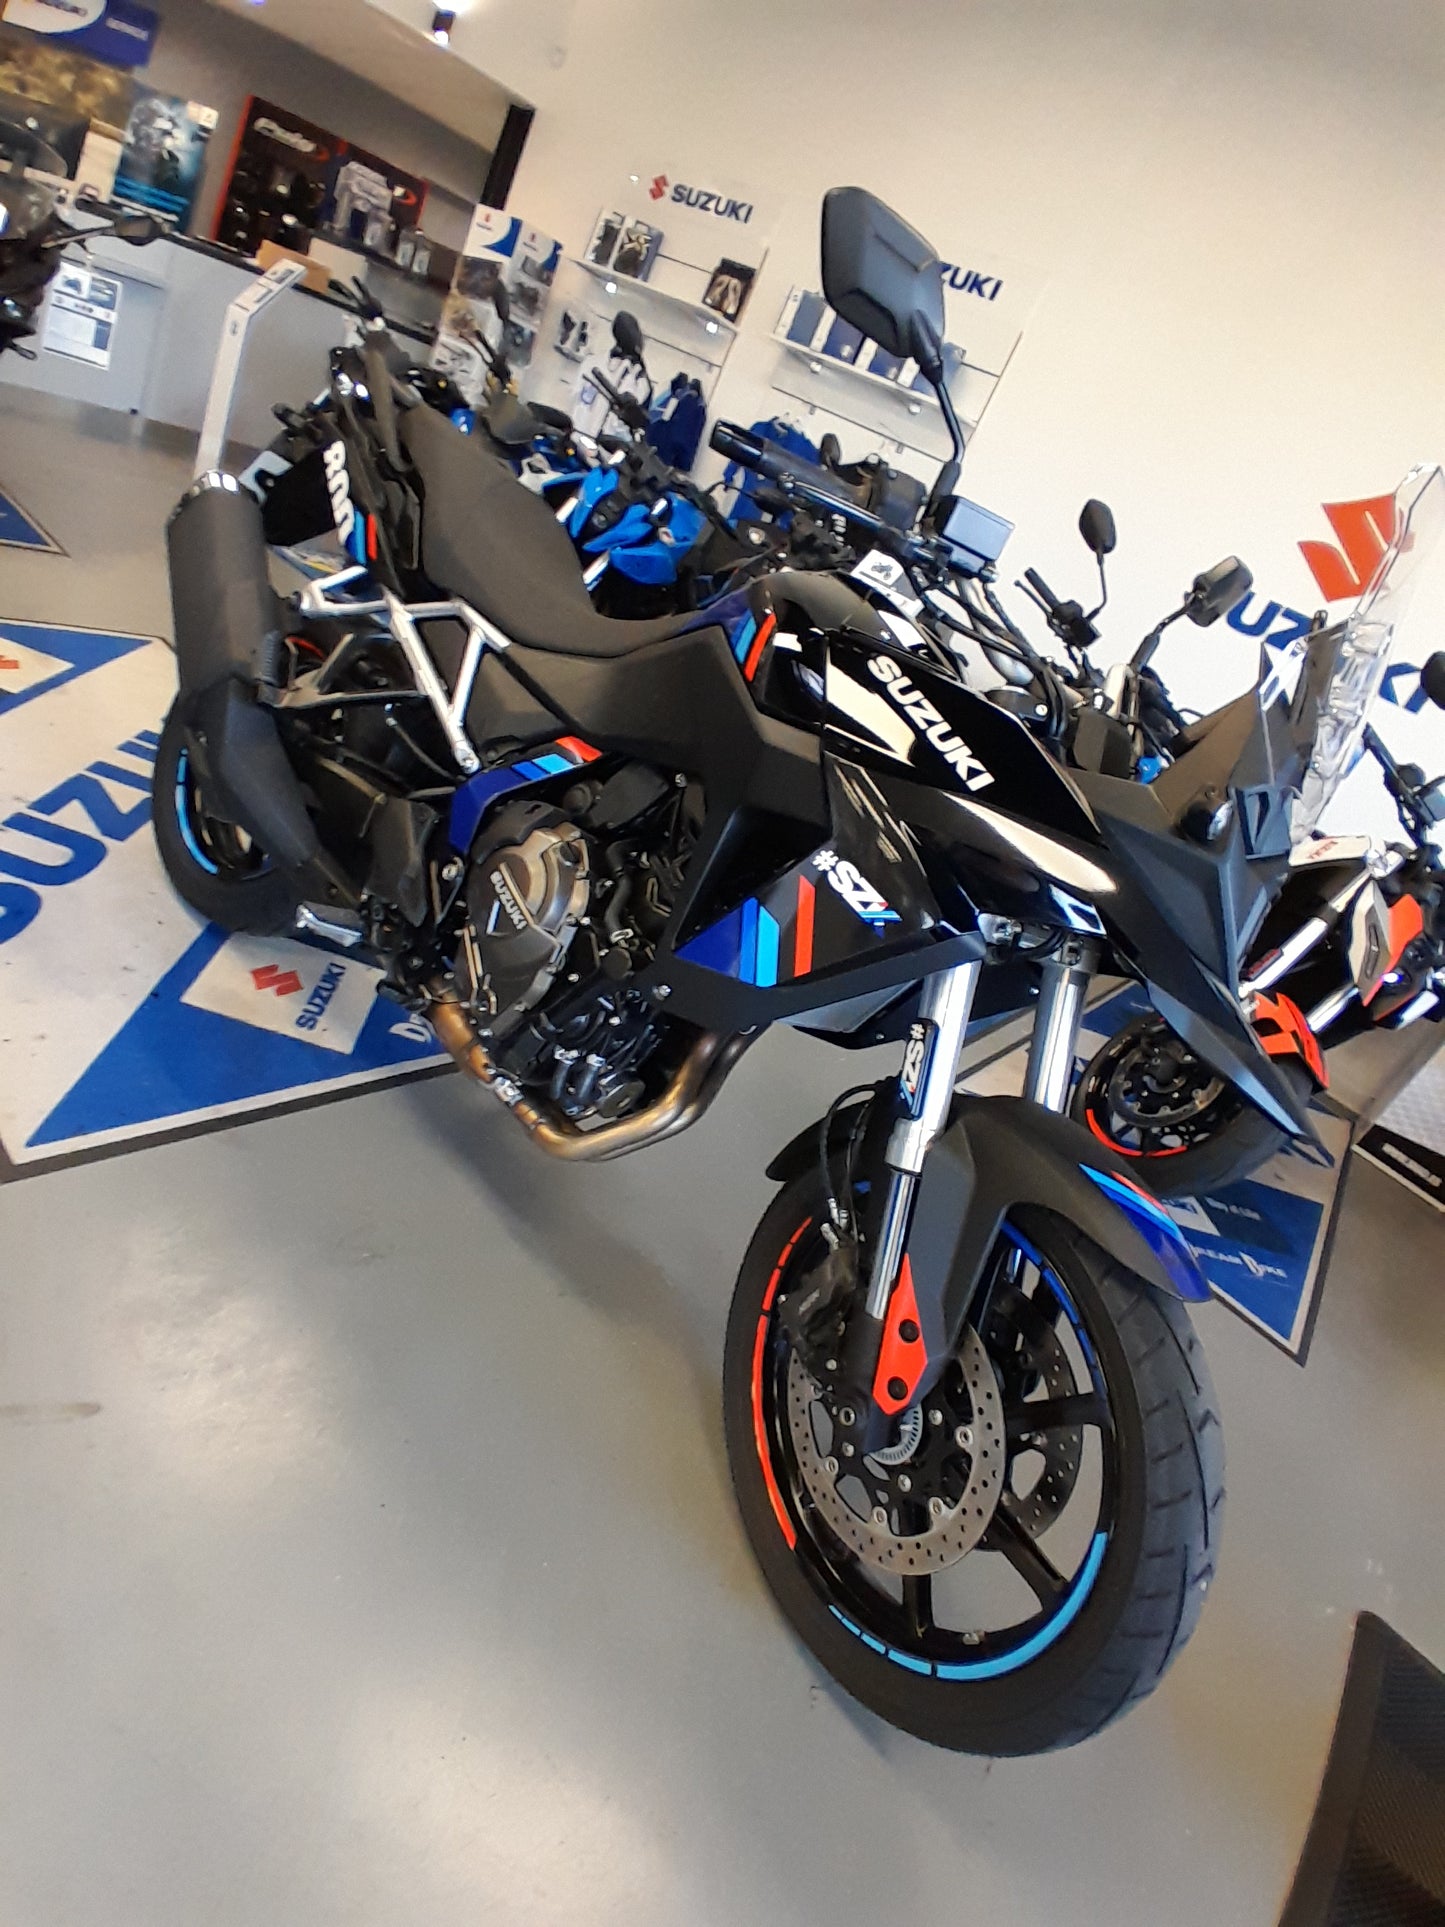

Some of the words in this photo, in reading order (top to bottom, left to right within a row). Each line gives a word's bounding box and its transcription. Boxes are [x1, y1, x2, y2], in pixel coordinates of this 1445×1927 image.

[671, 183, 753, 223] SUZUKI
[866, 655, 996, 792] SUZUKI
[490, 870, 528, 930] SUZUKI
[295, 961, 347, 1031] SUZUKI
